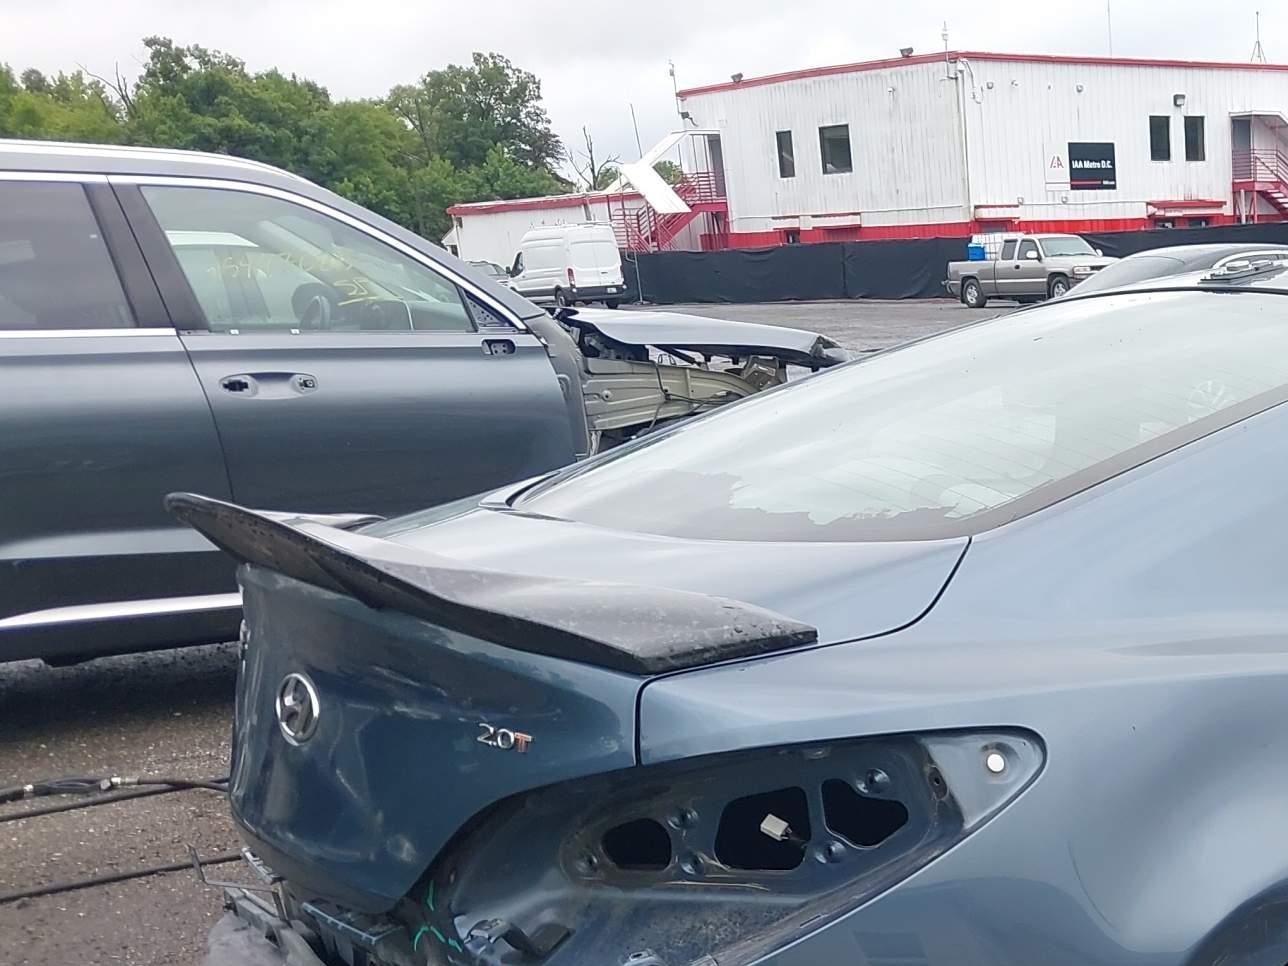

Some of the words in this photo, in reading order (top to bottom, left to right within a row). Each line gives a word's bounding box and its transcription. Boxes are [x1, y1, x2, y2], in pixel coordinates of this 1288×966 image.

[1072, 160, 1083, 168] IAA
[1084, 160, 1100, 169] Metro
[1101, 160, 1112, 168] D.C.
[476, 722, 533, 753] 2.0T
